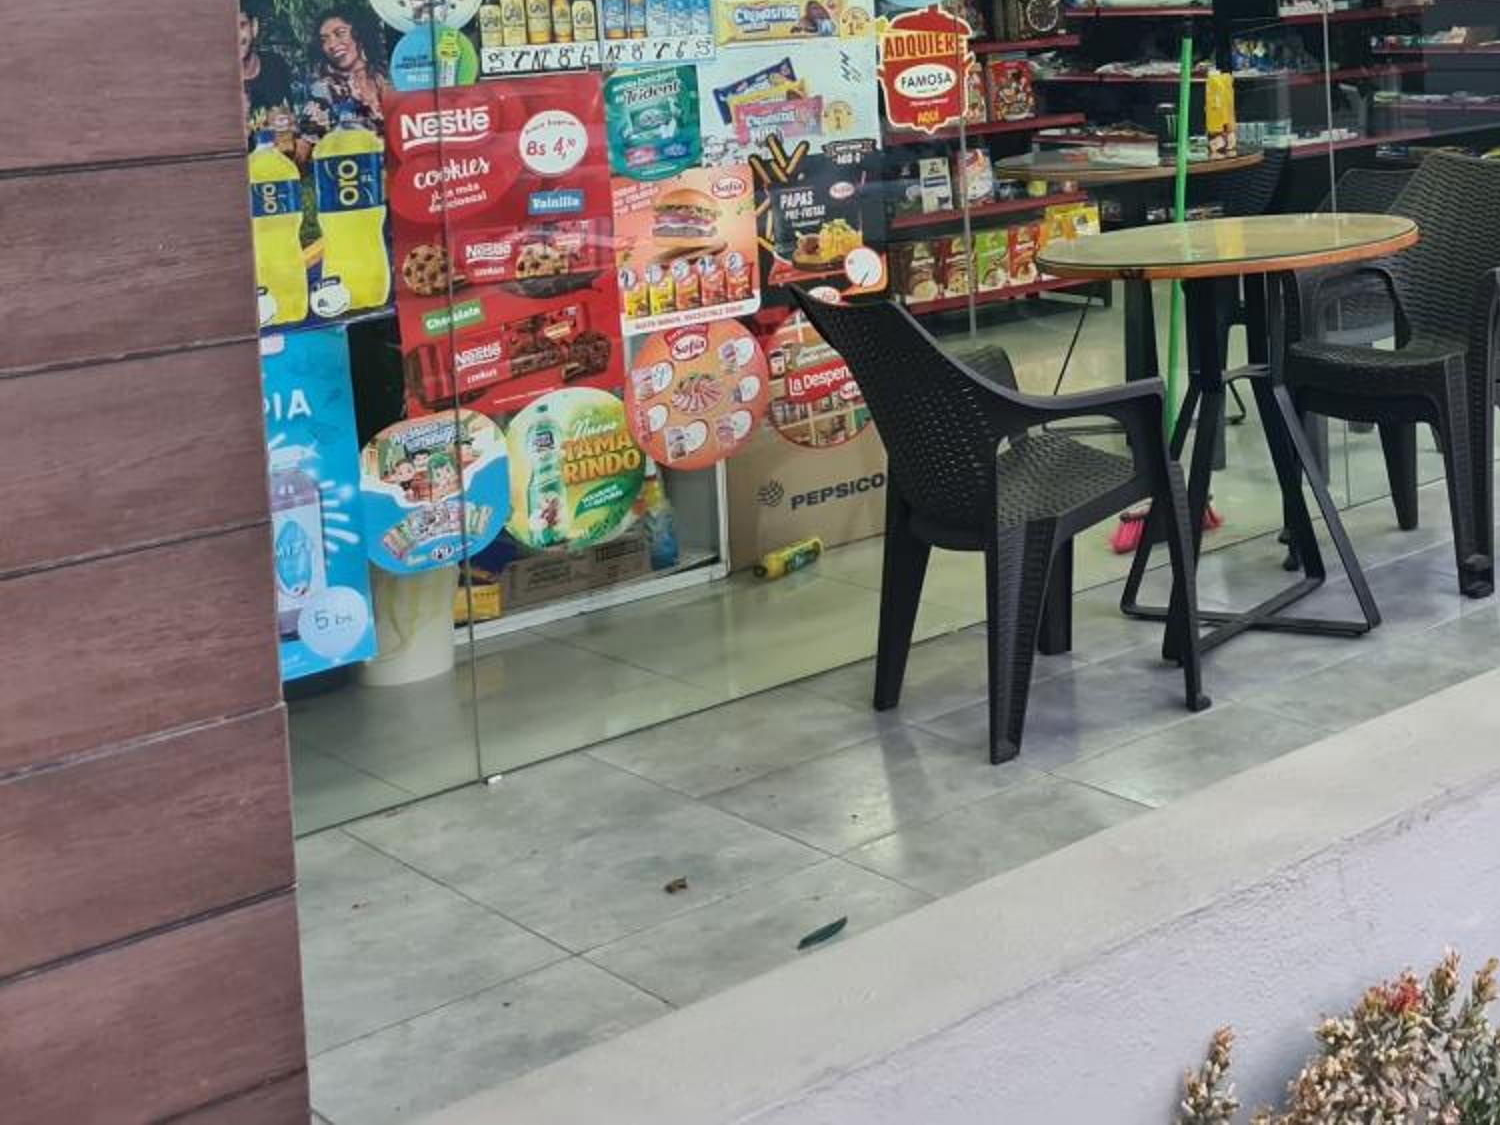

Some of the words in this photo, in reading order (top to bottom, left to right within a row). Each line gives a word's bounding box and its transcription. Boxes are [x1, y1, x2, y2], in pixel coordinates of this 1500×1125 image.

[883, 30, 965, 59] ADQUIERE
[624, 80, 681, 105] Trident
[901, 72, 953, 89] FAMOSA
[532, 195, 581, 209] Vainilla
[779, 190, 815, 210] PAPAS
[425, 305, 482, 330] Choolate
[804, 364, 850, 390] Despen
[564, 431, 633, 462] TAMA
[562, 448, 642, 485] RINDO
[790, 472, 886, 511] PEPSICO
